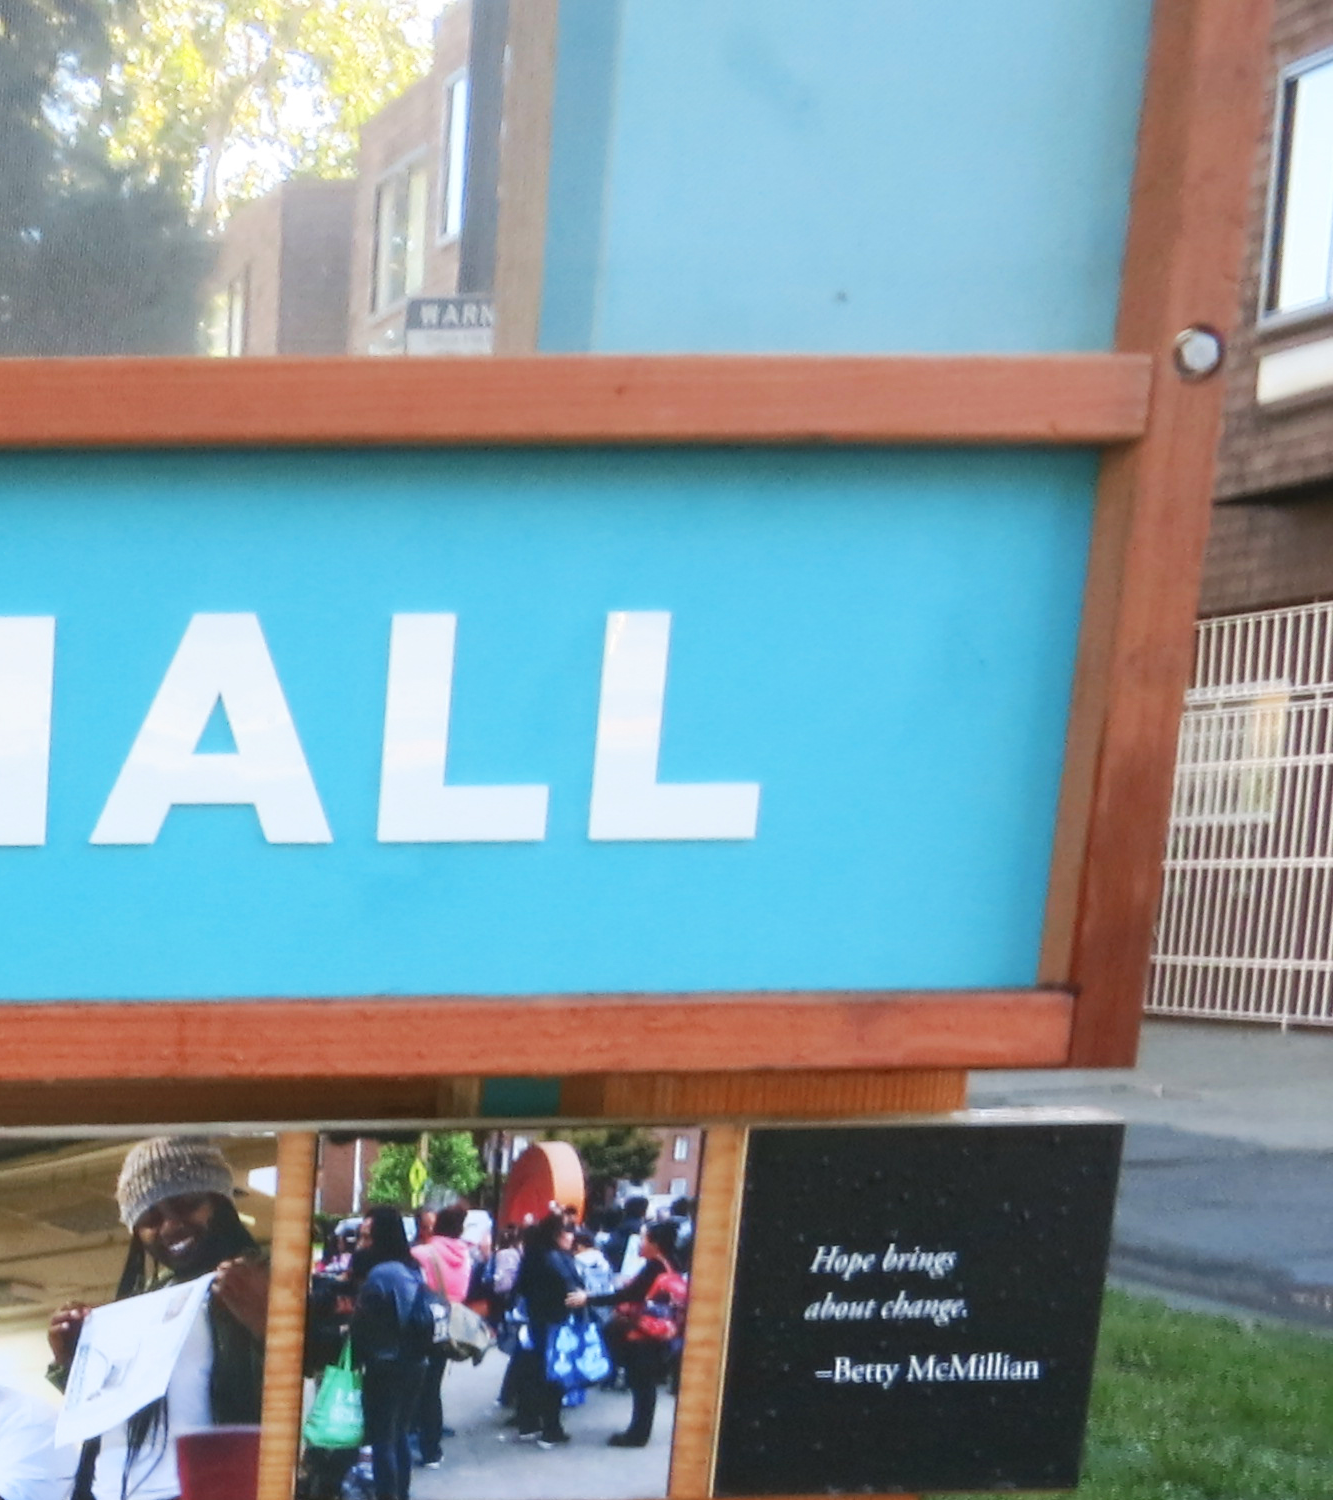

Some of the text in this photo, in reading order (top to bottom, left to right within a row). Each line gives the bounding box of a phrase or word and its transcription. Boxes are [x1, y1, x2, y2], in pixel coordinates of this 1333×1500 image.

[810, 1243, 957, 1281] Hope brings
[804, 1290, 968, 1326] about change.
[907, 1352, 1040, 1382] McMillian
